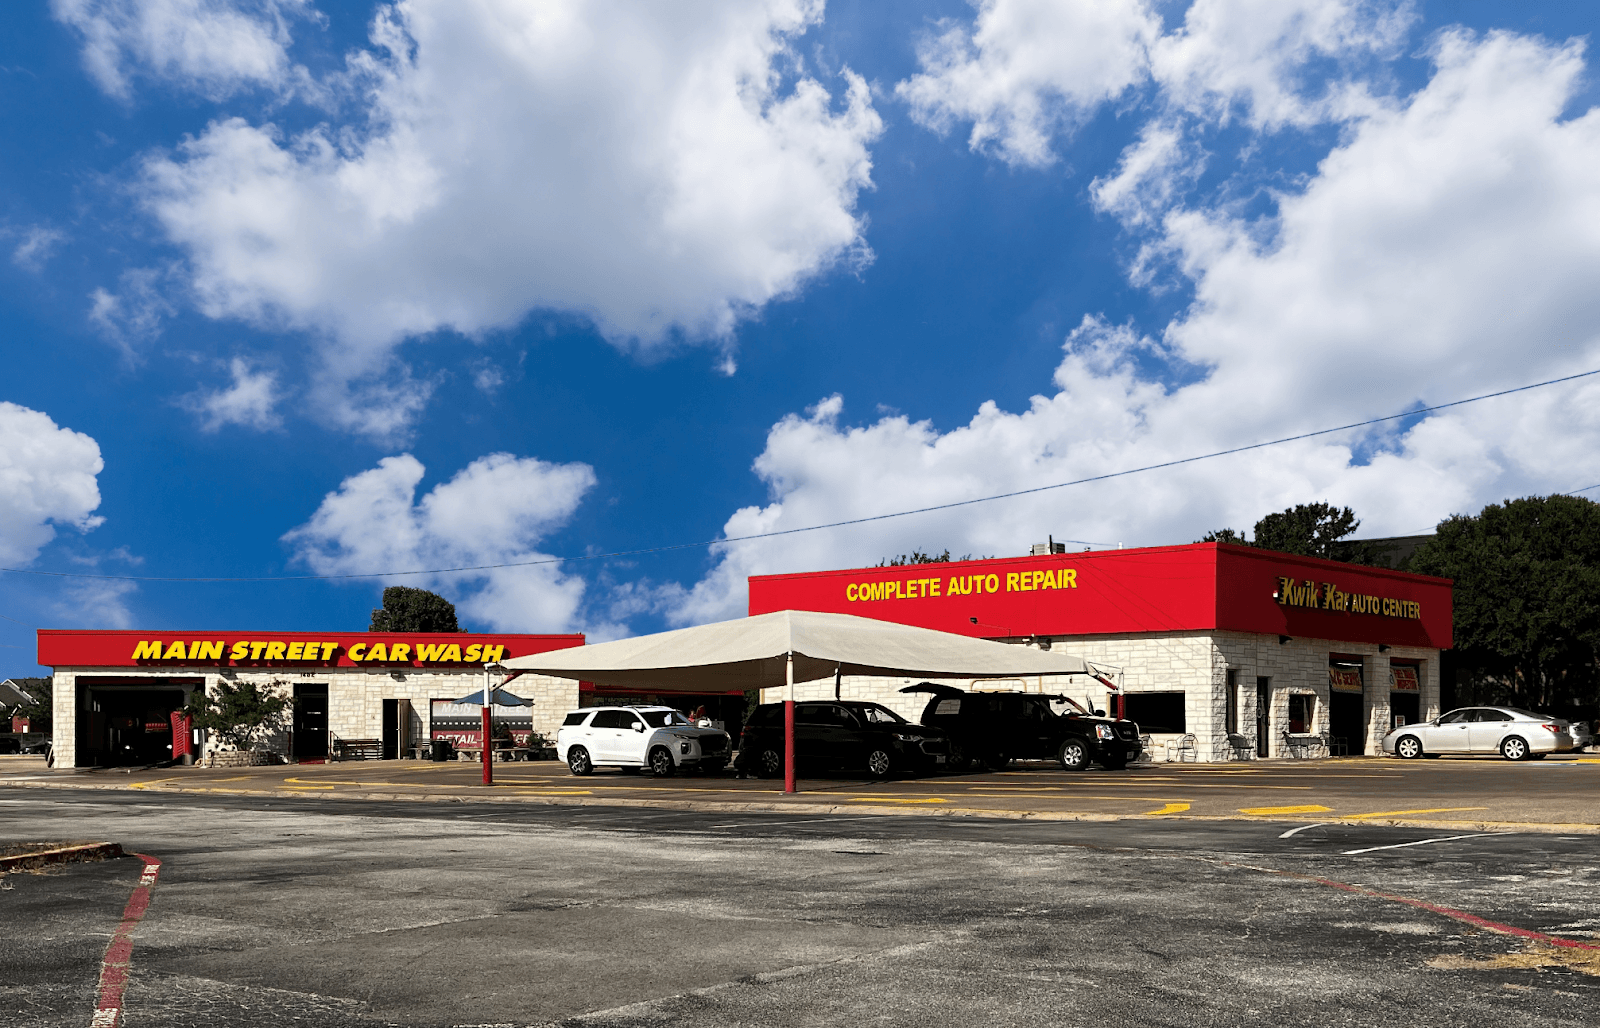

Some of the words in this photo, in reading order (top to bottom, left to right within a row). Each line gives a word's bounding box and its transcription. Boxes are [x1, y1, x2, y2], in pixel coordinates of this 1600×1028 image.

[846, 577, 941, 602] COMPLETE
[947, 573, 1000, 596] AUTO
[1006, 568, 1078, 592] REPAIR
[1279, 576, 1319, 609] Kwik
[1322, 582, 1350, 612] Kar
[1351, 593, 1381, 615] AUTO
[1382, 597, 1421, 620] CENTER
[131, 640, 225, 660] MAIN
[229, 640, 339, 661] STREET
[347, 642, 411, 662] CAR
[415, 643, 505, 663] WASH
[441, 703, 472, 713] MAIN
